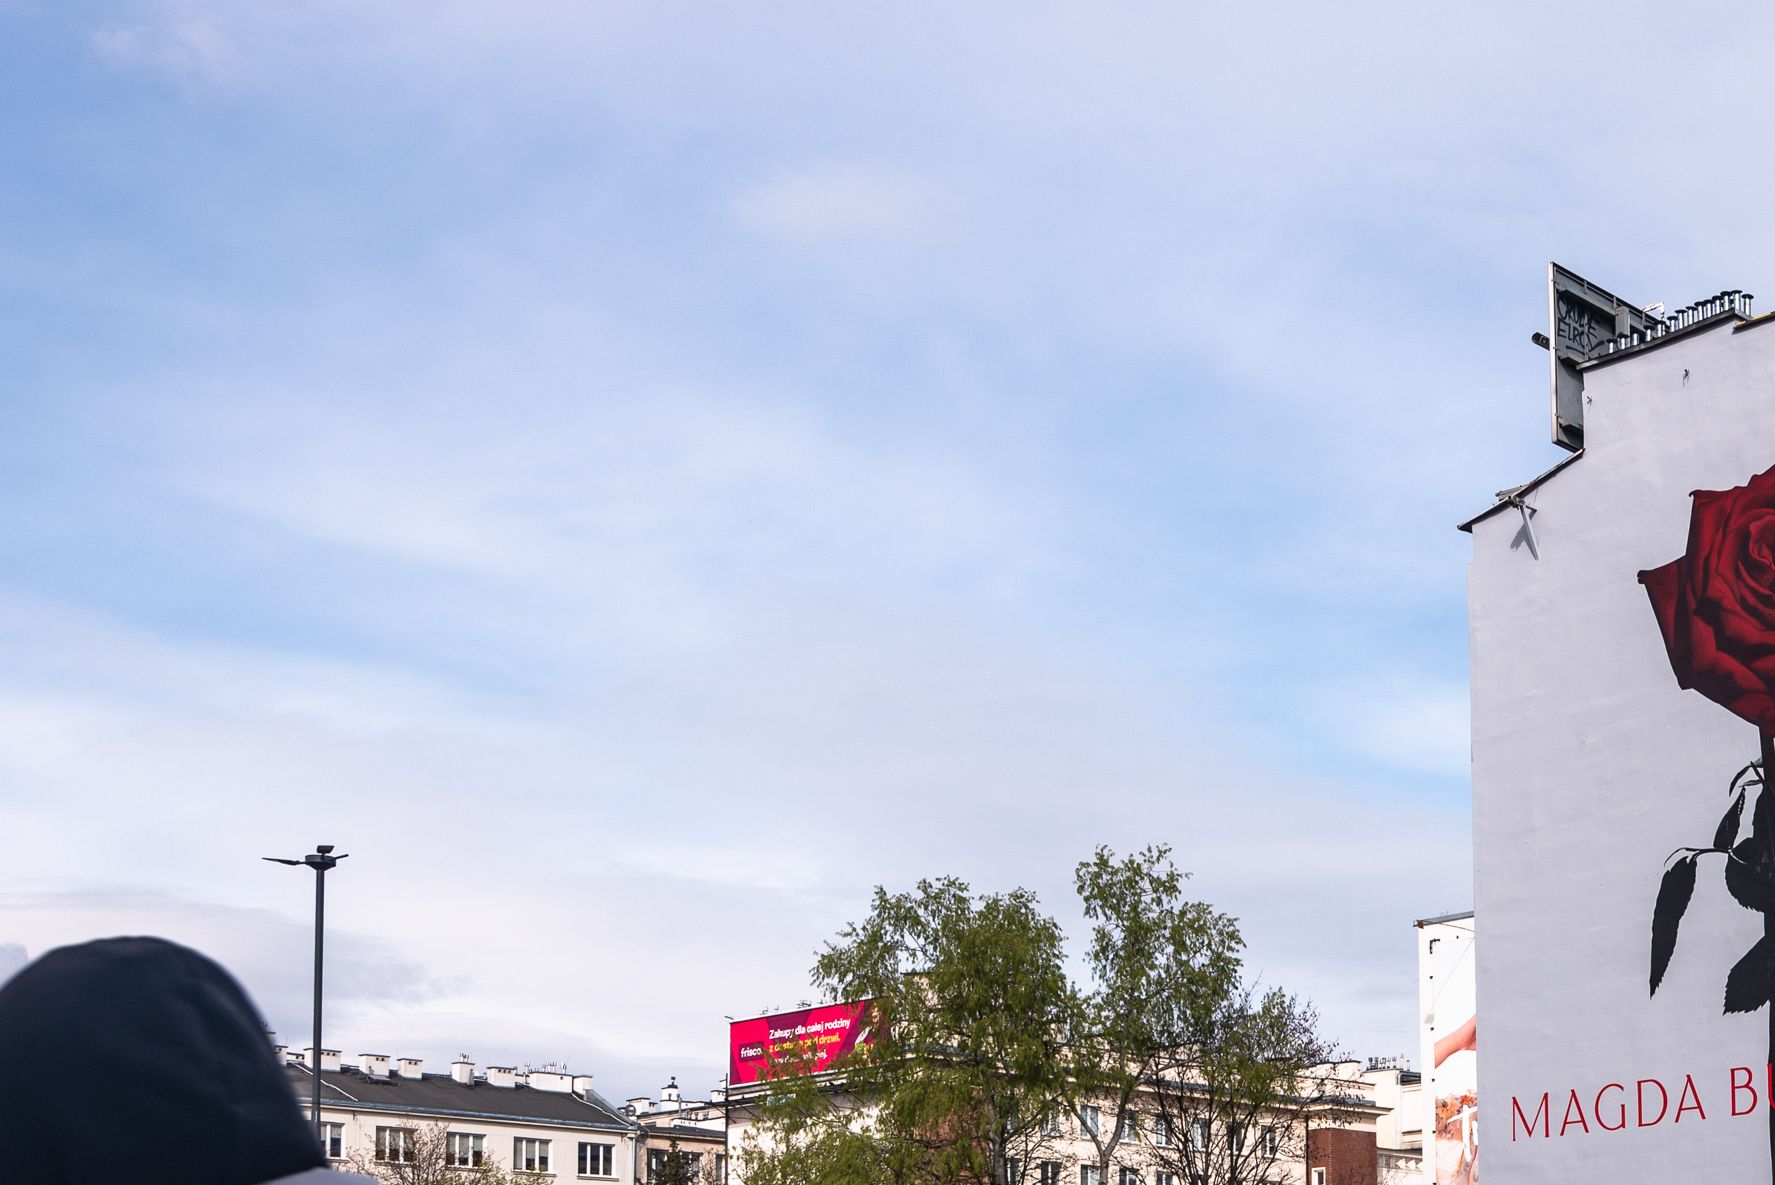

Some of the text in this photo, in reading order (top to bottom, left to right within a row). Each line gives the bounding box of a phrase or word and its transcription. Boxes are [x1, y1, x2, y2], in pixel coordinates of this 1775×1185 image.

[769, 1029, 794, 1039] Zakupy
[795, 1025, 806, 1034] dla
[824, 1018, 851, 1030] rodziny
[819, 1032, 840, 1044] drzwi.
[1512, 1074, 1706, 1141] MAGDA
